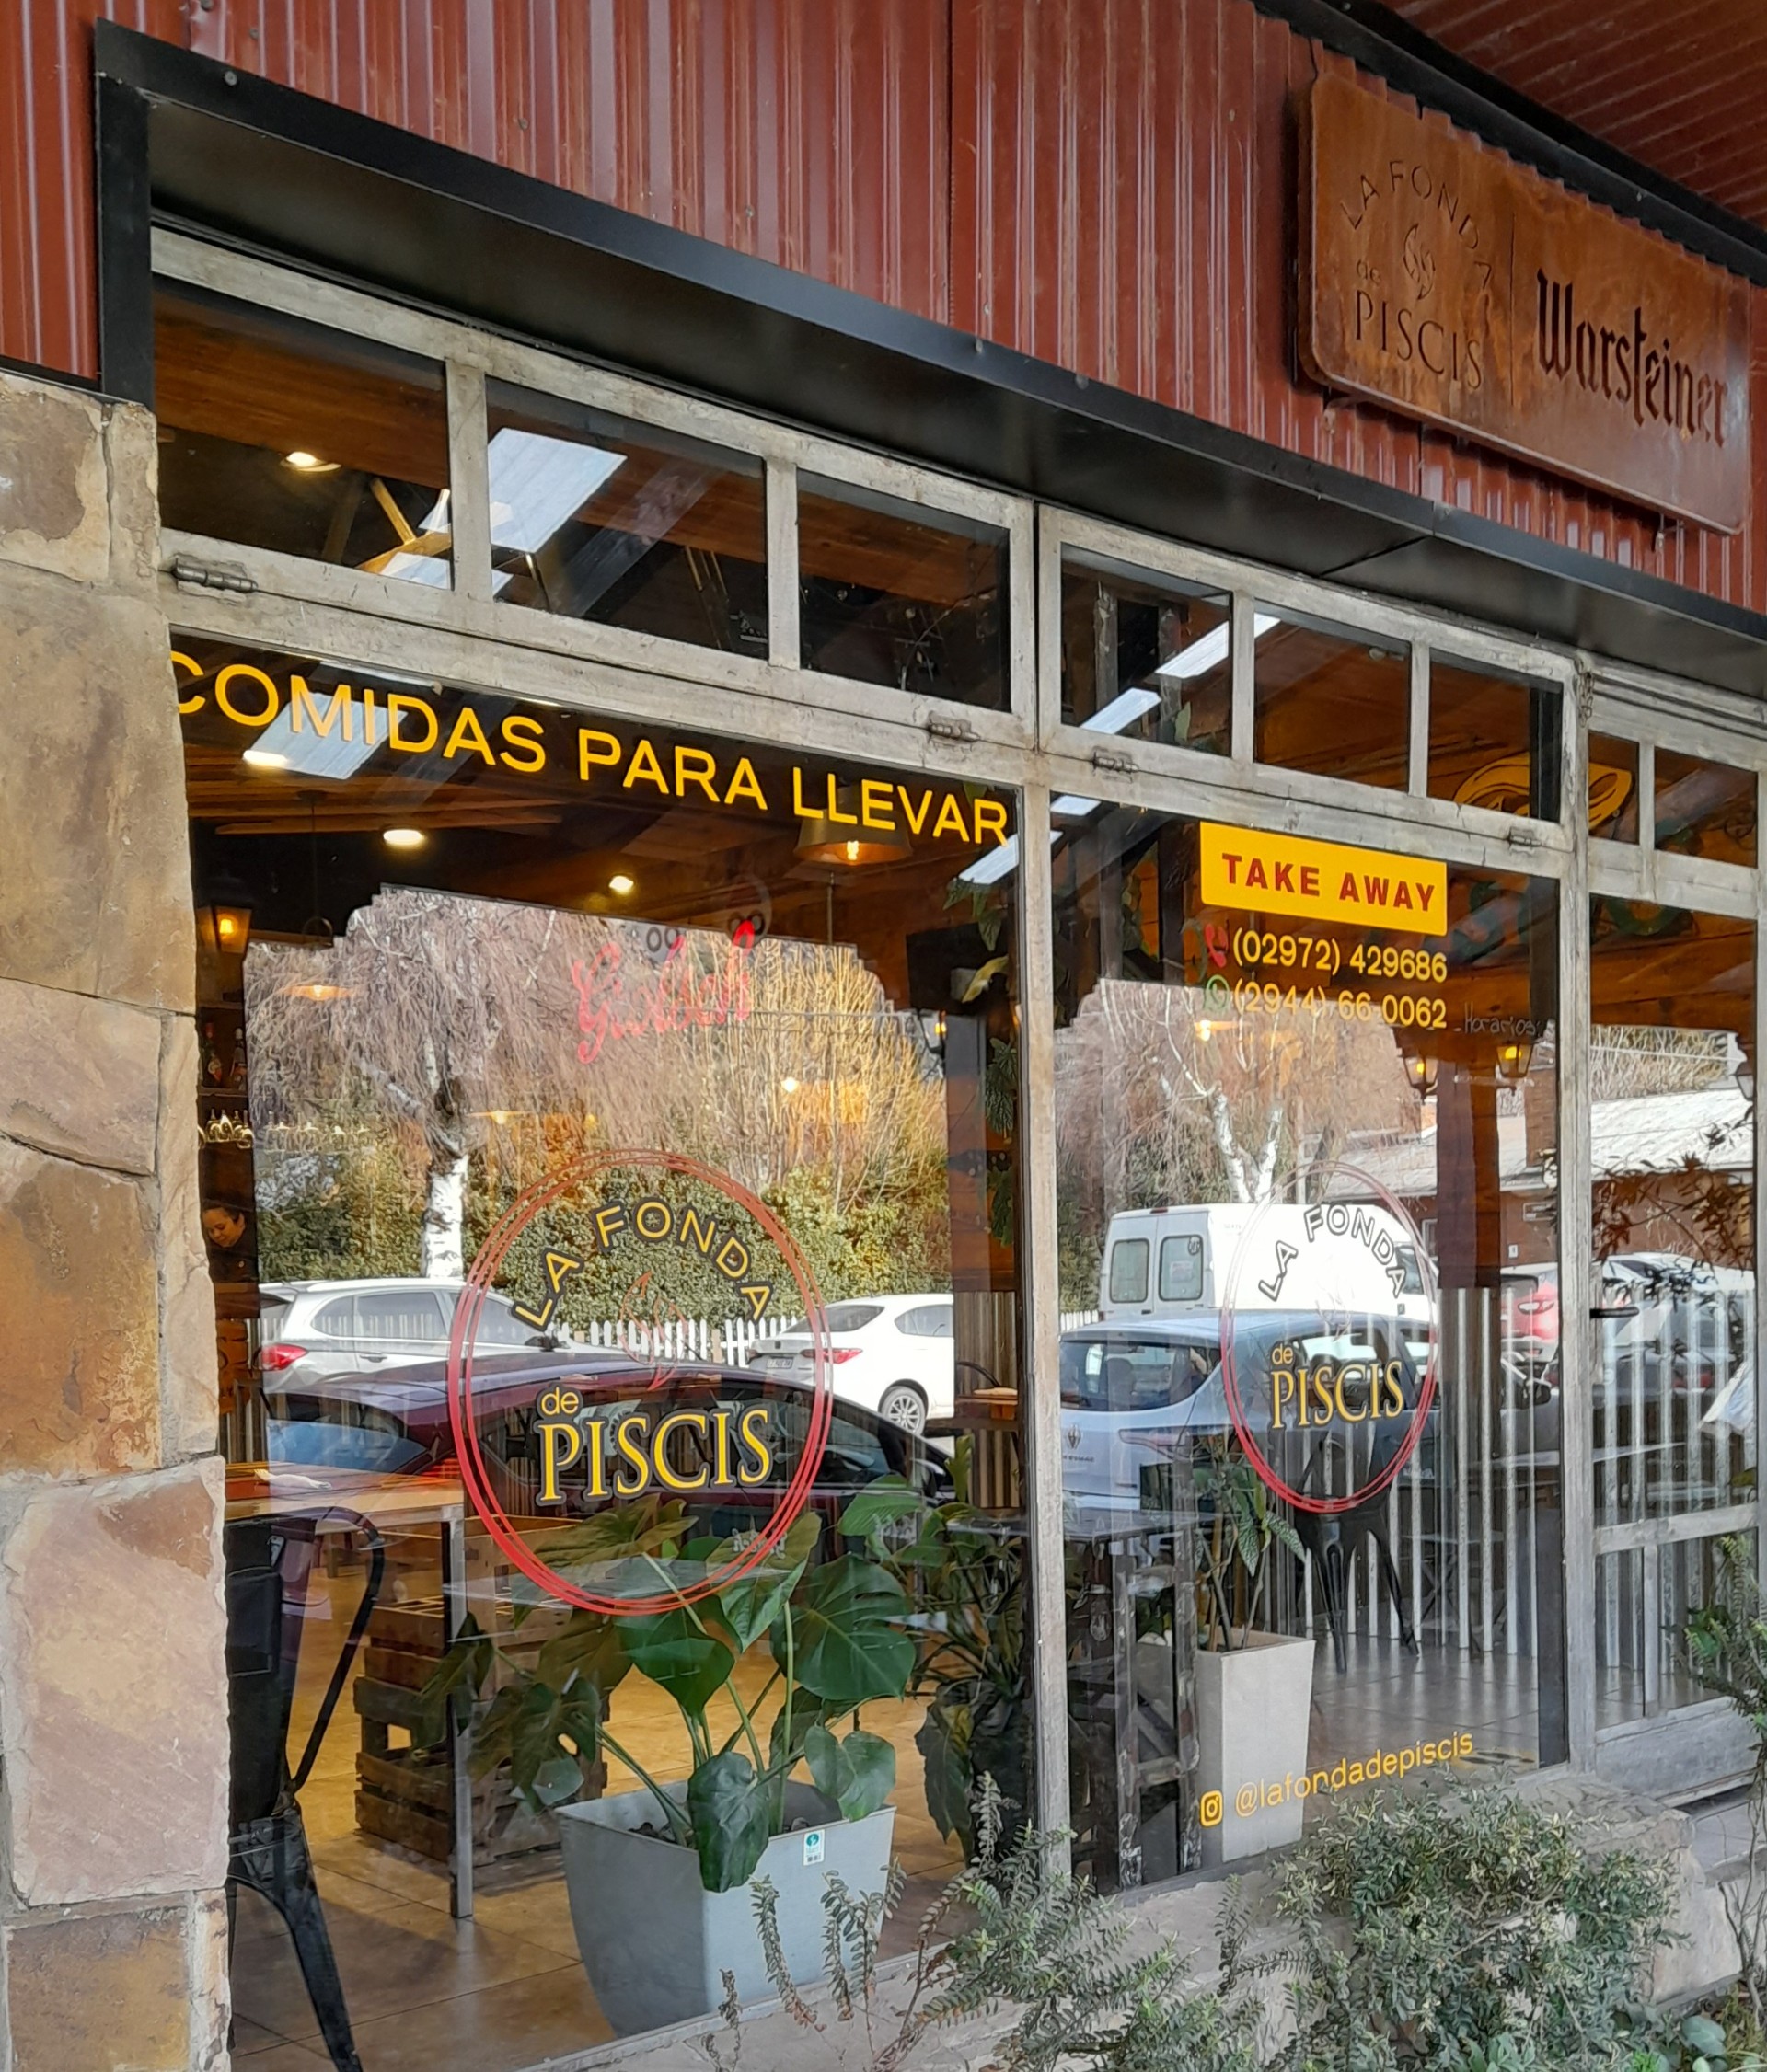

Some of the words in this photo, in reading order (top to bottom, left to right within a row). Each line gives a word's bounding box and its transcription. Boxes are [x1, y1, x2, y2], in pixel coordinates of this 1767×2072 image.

[1340, 174, 1380, 230] LA
[1356, 289, 1483, 391] PISCIS
[578, 728, 768, 811] PARA
[792, 766, 1009, 847] LLEVAR
[1221, 852, 1321, 897] TAKE
[1339, 871, 1435, 912] AWAY
[1233, 927, 1341, 975] (02972)
[1350, 945, 1448, 983] 429686
[1234, 978, 1327, 1015] (2944)
[515, 1251, 580, 1328] LA
[595, 1201, 770, 1319] FONDA
[1257, 1239, 1299, 1302] LA
[1302, 1203, 1408, 1298] FONDA
[1271, 1344, 1294, 1365] de
[541, 1387, 579, 1416] de
[1270, 1360, 1404, 1430] PISCIS
[538, 1408, 771, 1502] PISCIS
[1235, 1732, 1473, 1818] @lafondadepiscis
